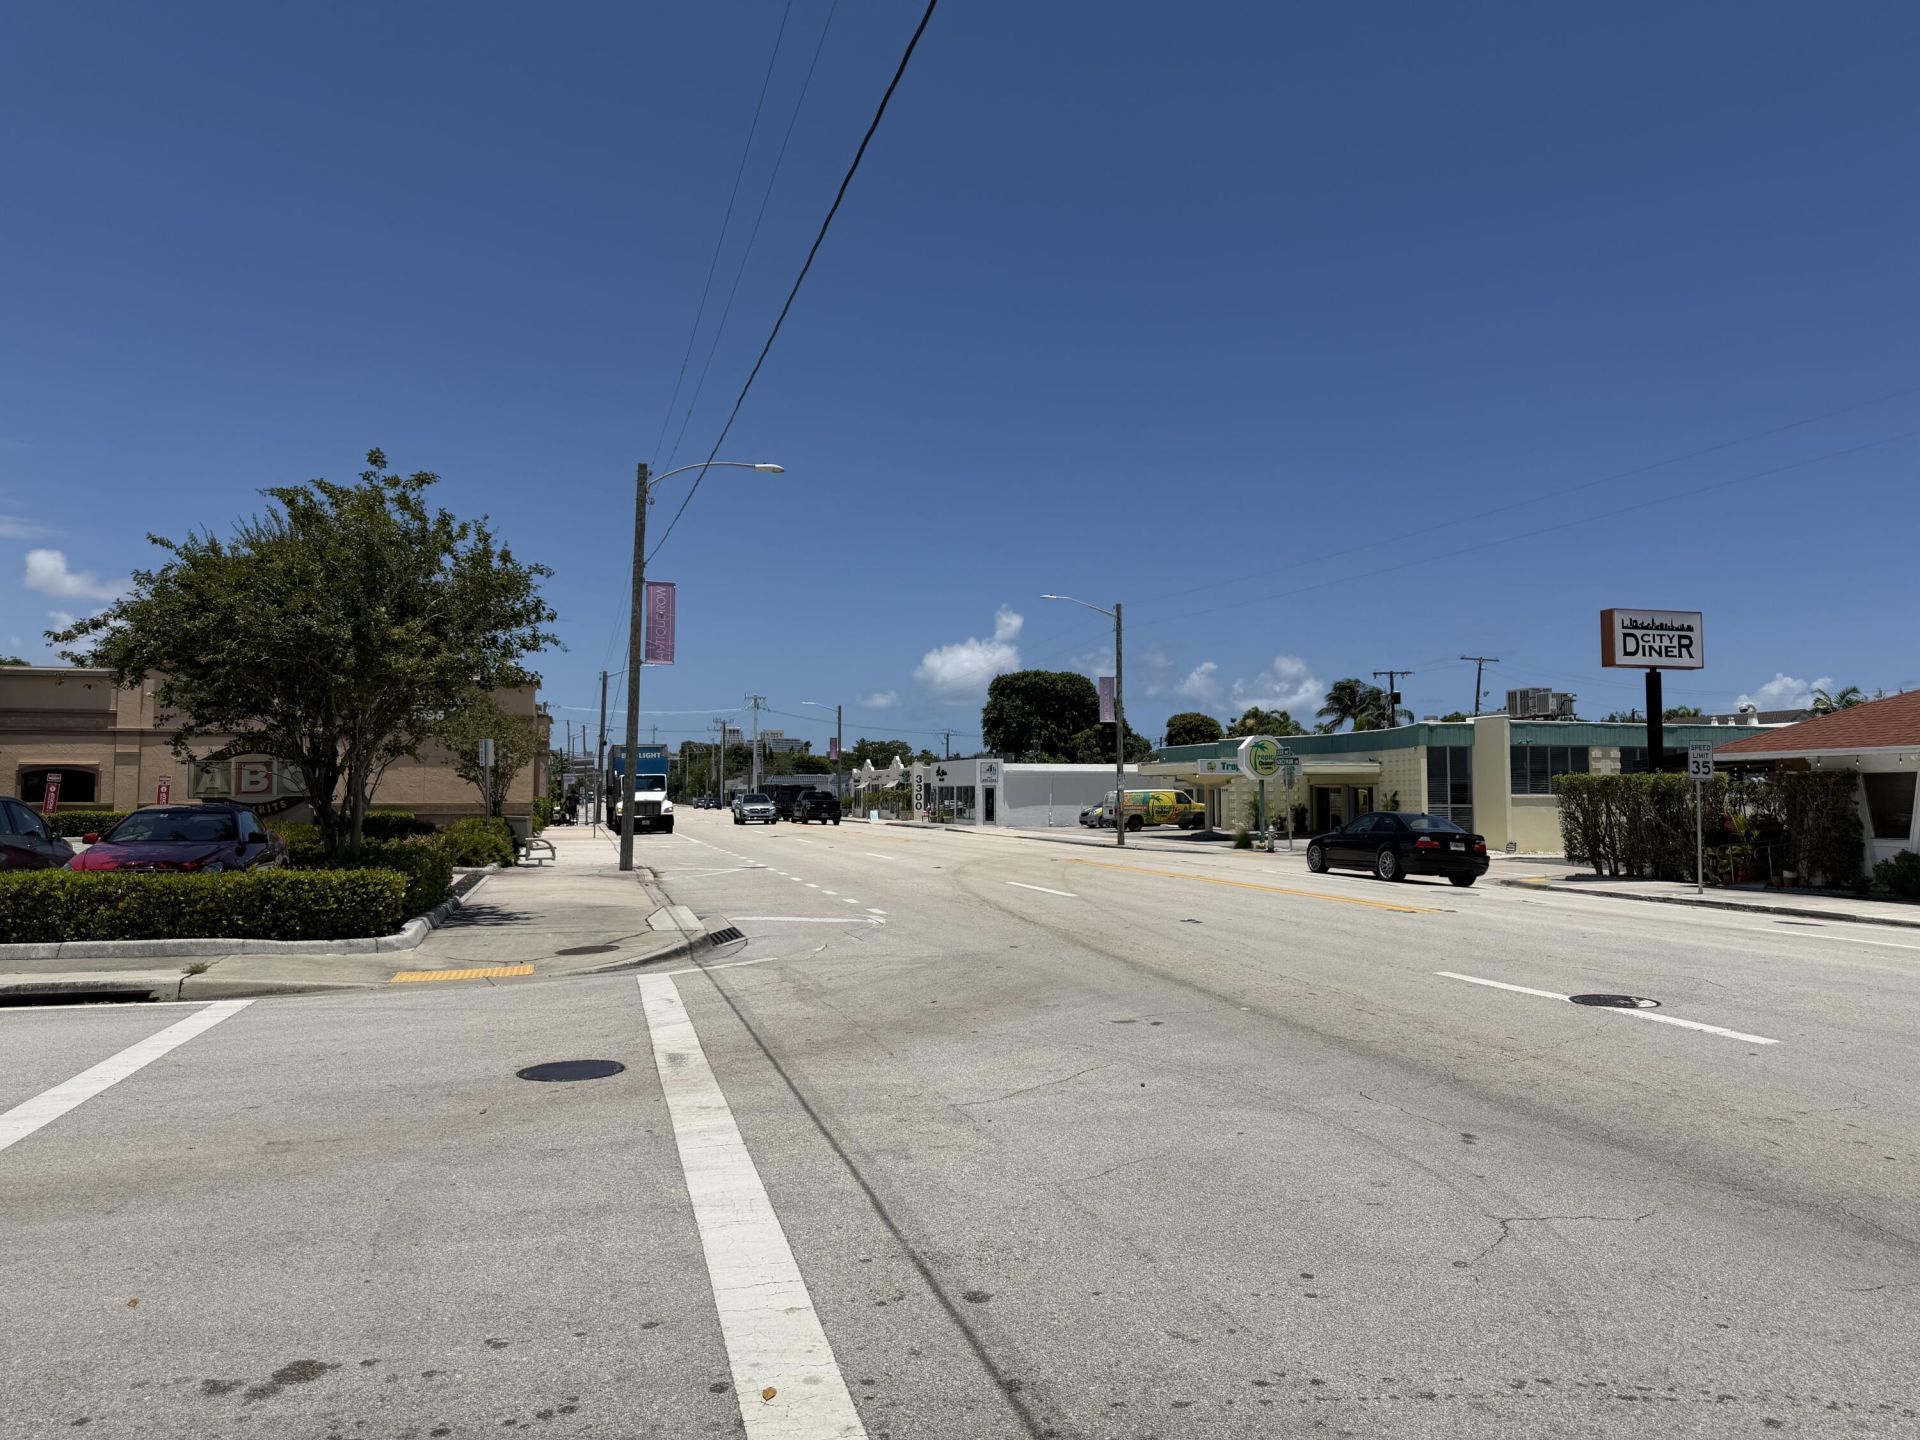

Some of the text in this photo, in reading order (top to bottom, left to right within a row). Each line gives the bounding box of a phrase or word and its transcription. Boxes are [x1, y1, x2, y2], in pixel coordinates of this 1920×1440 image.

[656, 586, 666, 661] ANTIQUE ROW
[1623, 632, 1695, 659] DINER
[1641, 633, 1676, 644] CITY
[195, 762, 309, 794] ABC
[1692, 760, 1711, 775] 35
[915, 774, 923, 811] 3300
